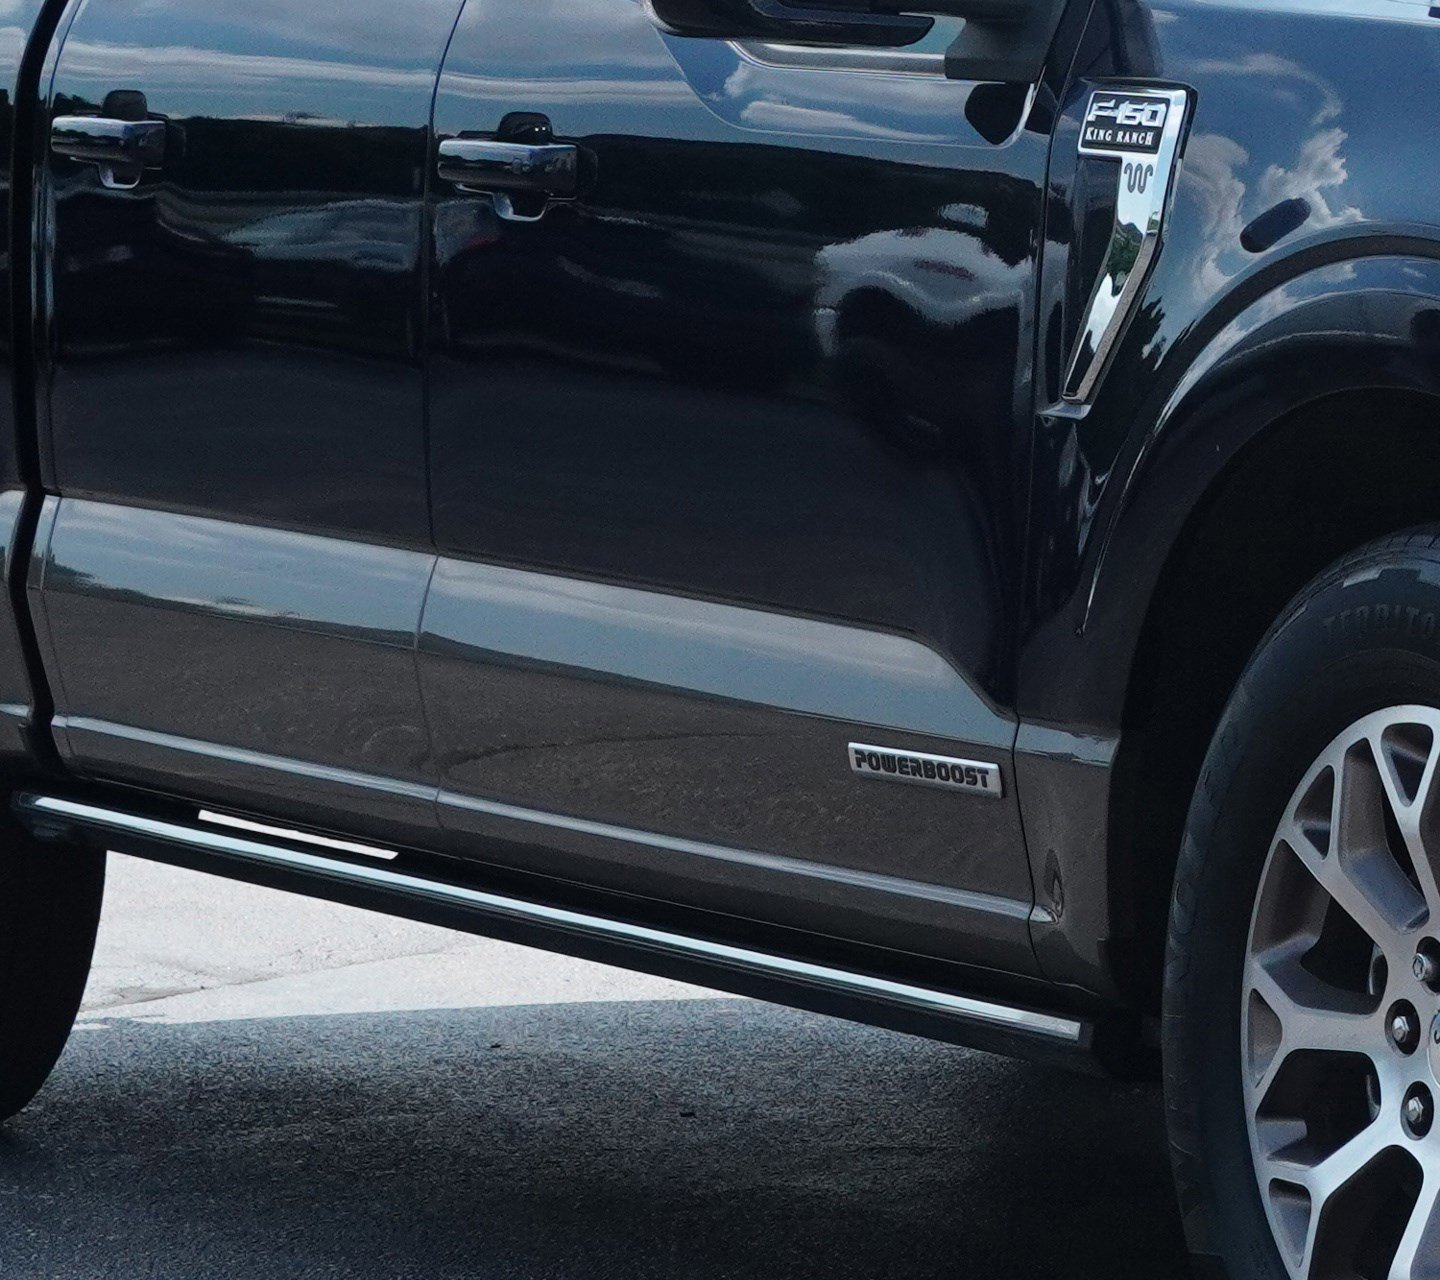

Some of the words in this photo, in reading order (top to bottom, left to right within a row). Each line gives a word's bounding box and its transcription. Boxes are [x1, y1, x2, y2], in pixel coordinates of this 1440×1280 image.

[1087, 98, 1167, 128] F-150
[1084, 126, 1112, 142] KING
[1116, 130, 1154, 146] RANCH
[854, 749, 990, 789] POWERBOOST
